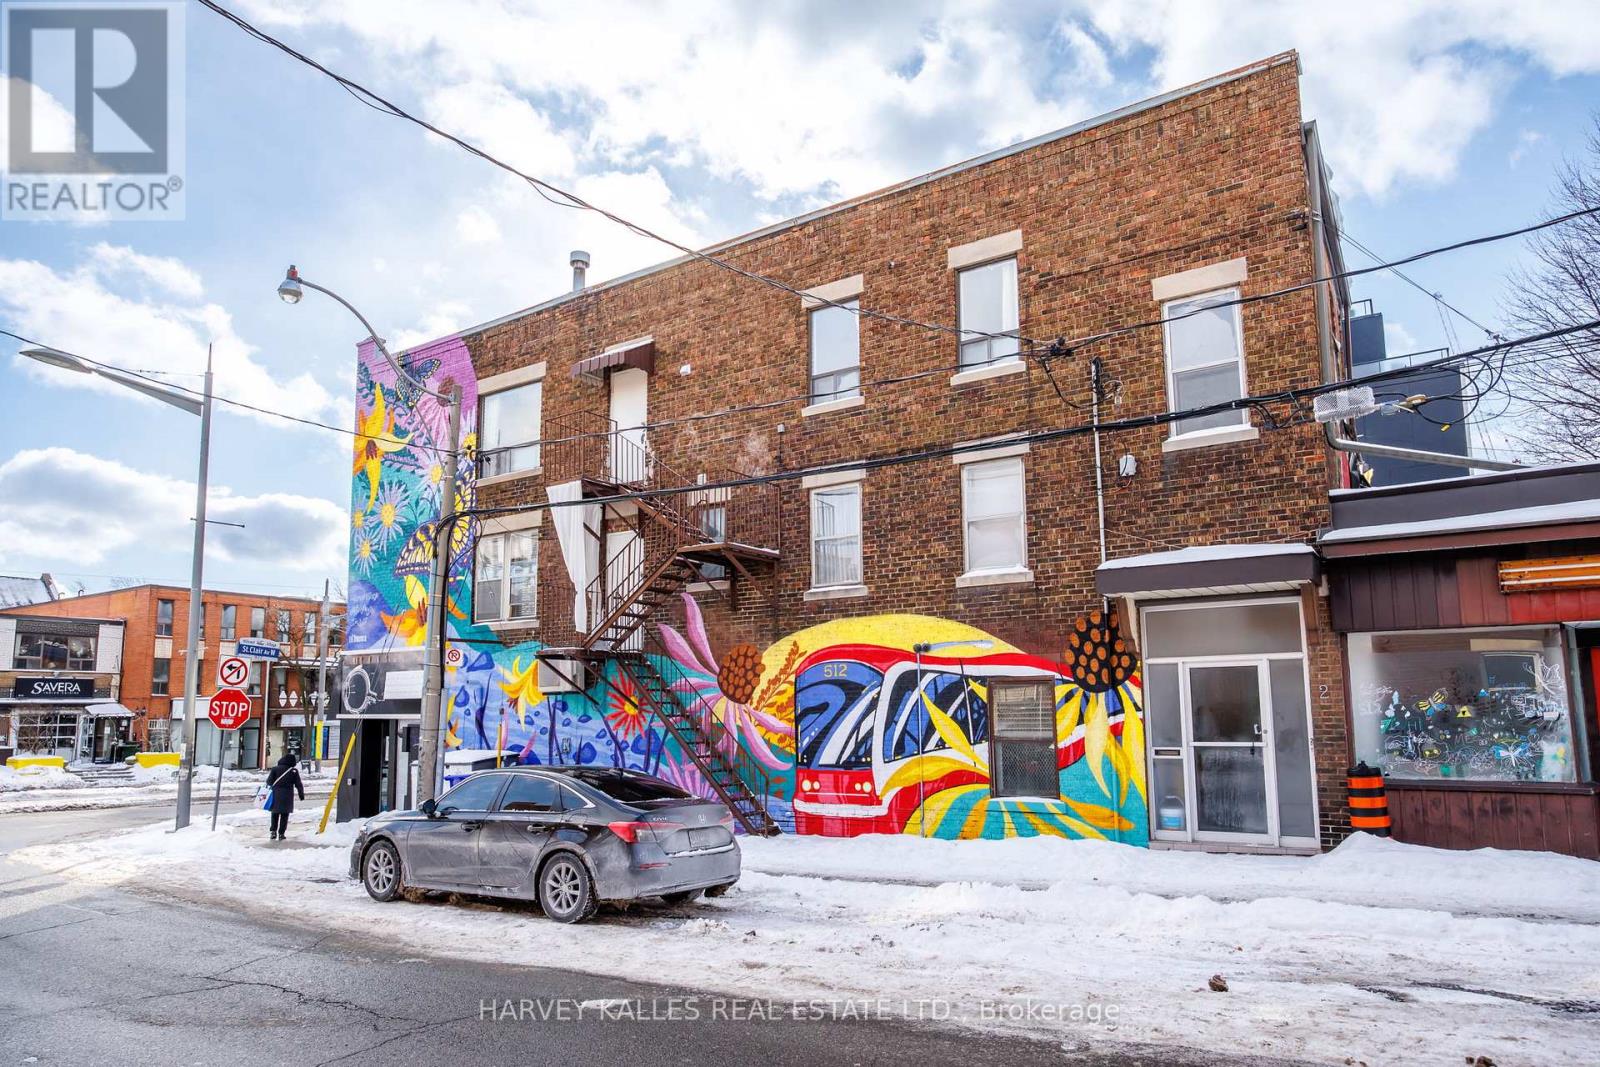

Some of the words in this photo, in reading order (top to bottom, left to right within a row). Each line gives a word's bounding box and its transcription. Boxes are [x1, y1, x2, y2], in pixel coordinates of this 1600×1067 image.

[823, 663, 848, 678] 512
[31, 682, 81, 695] SAVERA
[1319, 684, 1329, 699] 2
[210, 700, 248, 717] STOP
